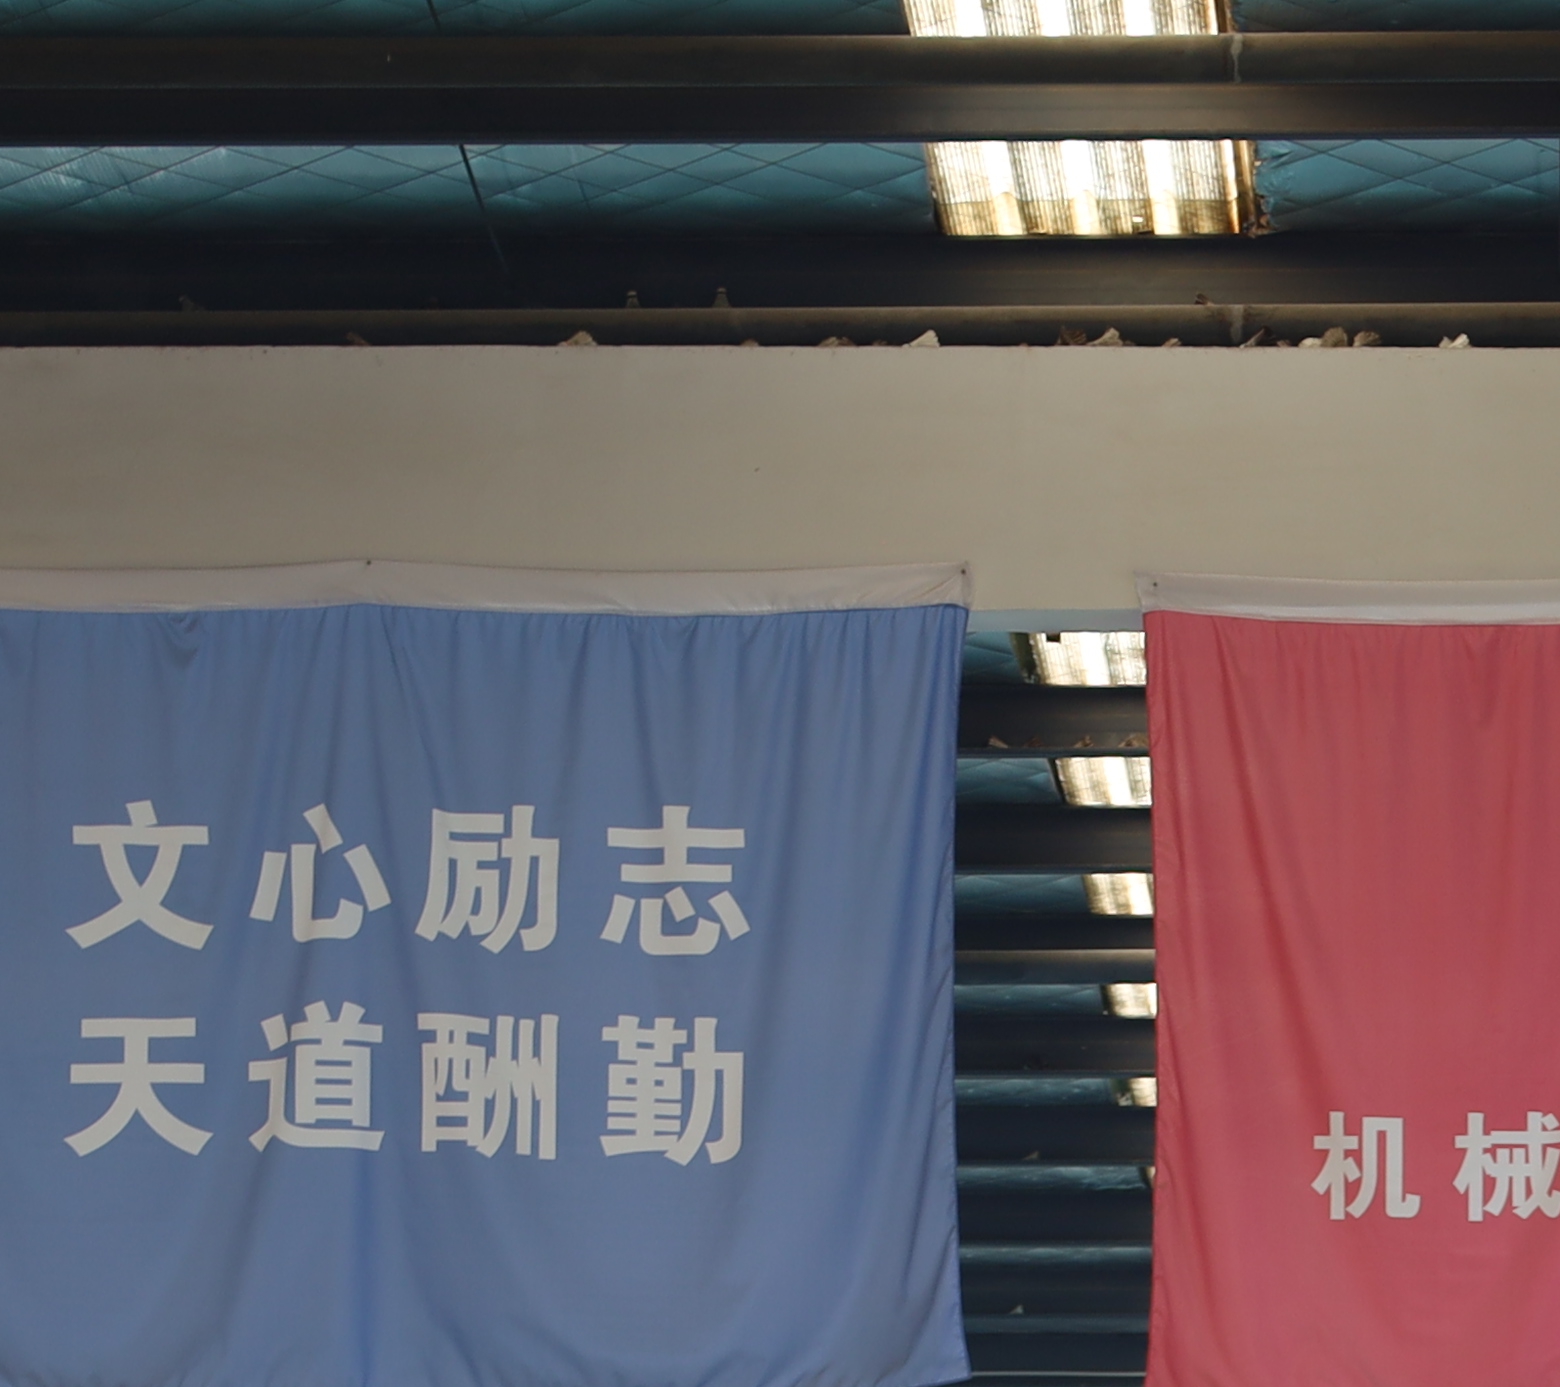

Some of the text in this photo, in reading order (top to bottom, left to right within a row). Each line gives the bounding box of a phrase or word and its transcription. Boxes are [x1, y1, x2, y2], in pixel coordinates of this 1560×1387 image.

[67, 802, 749, 955] 文心励志
[66, 1003, 743, 1165] 天道酬勤
